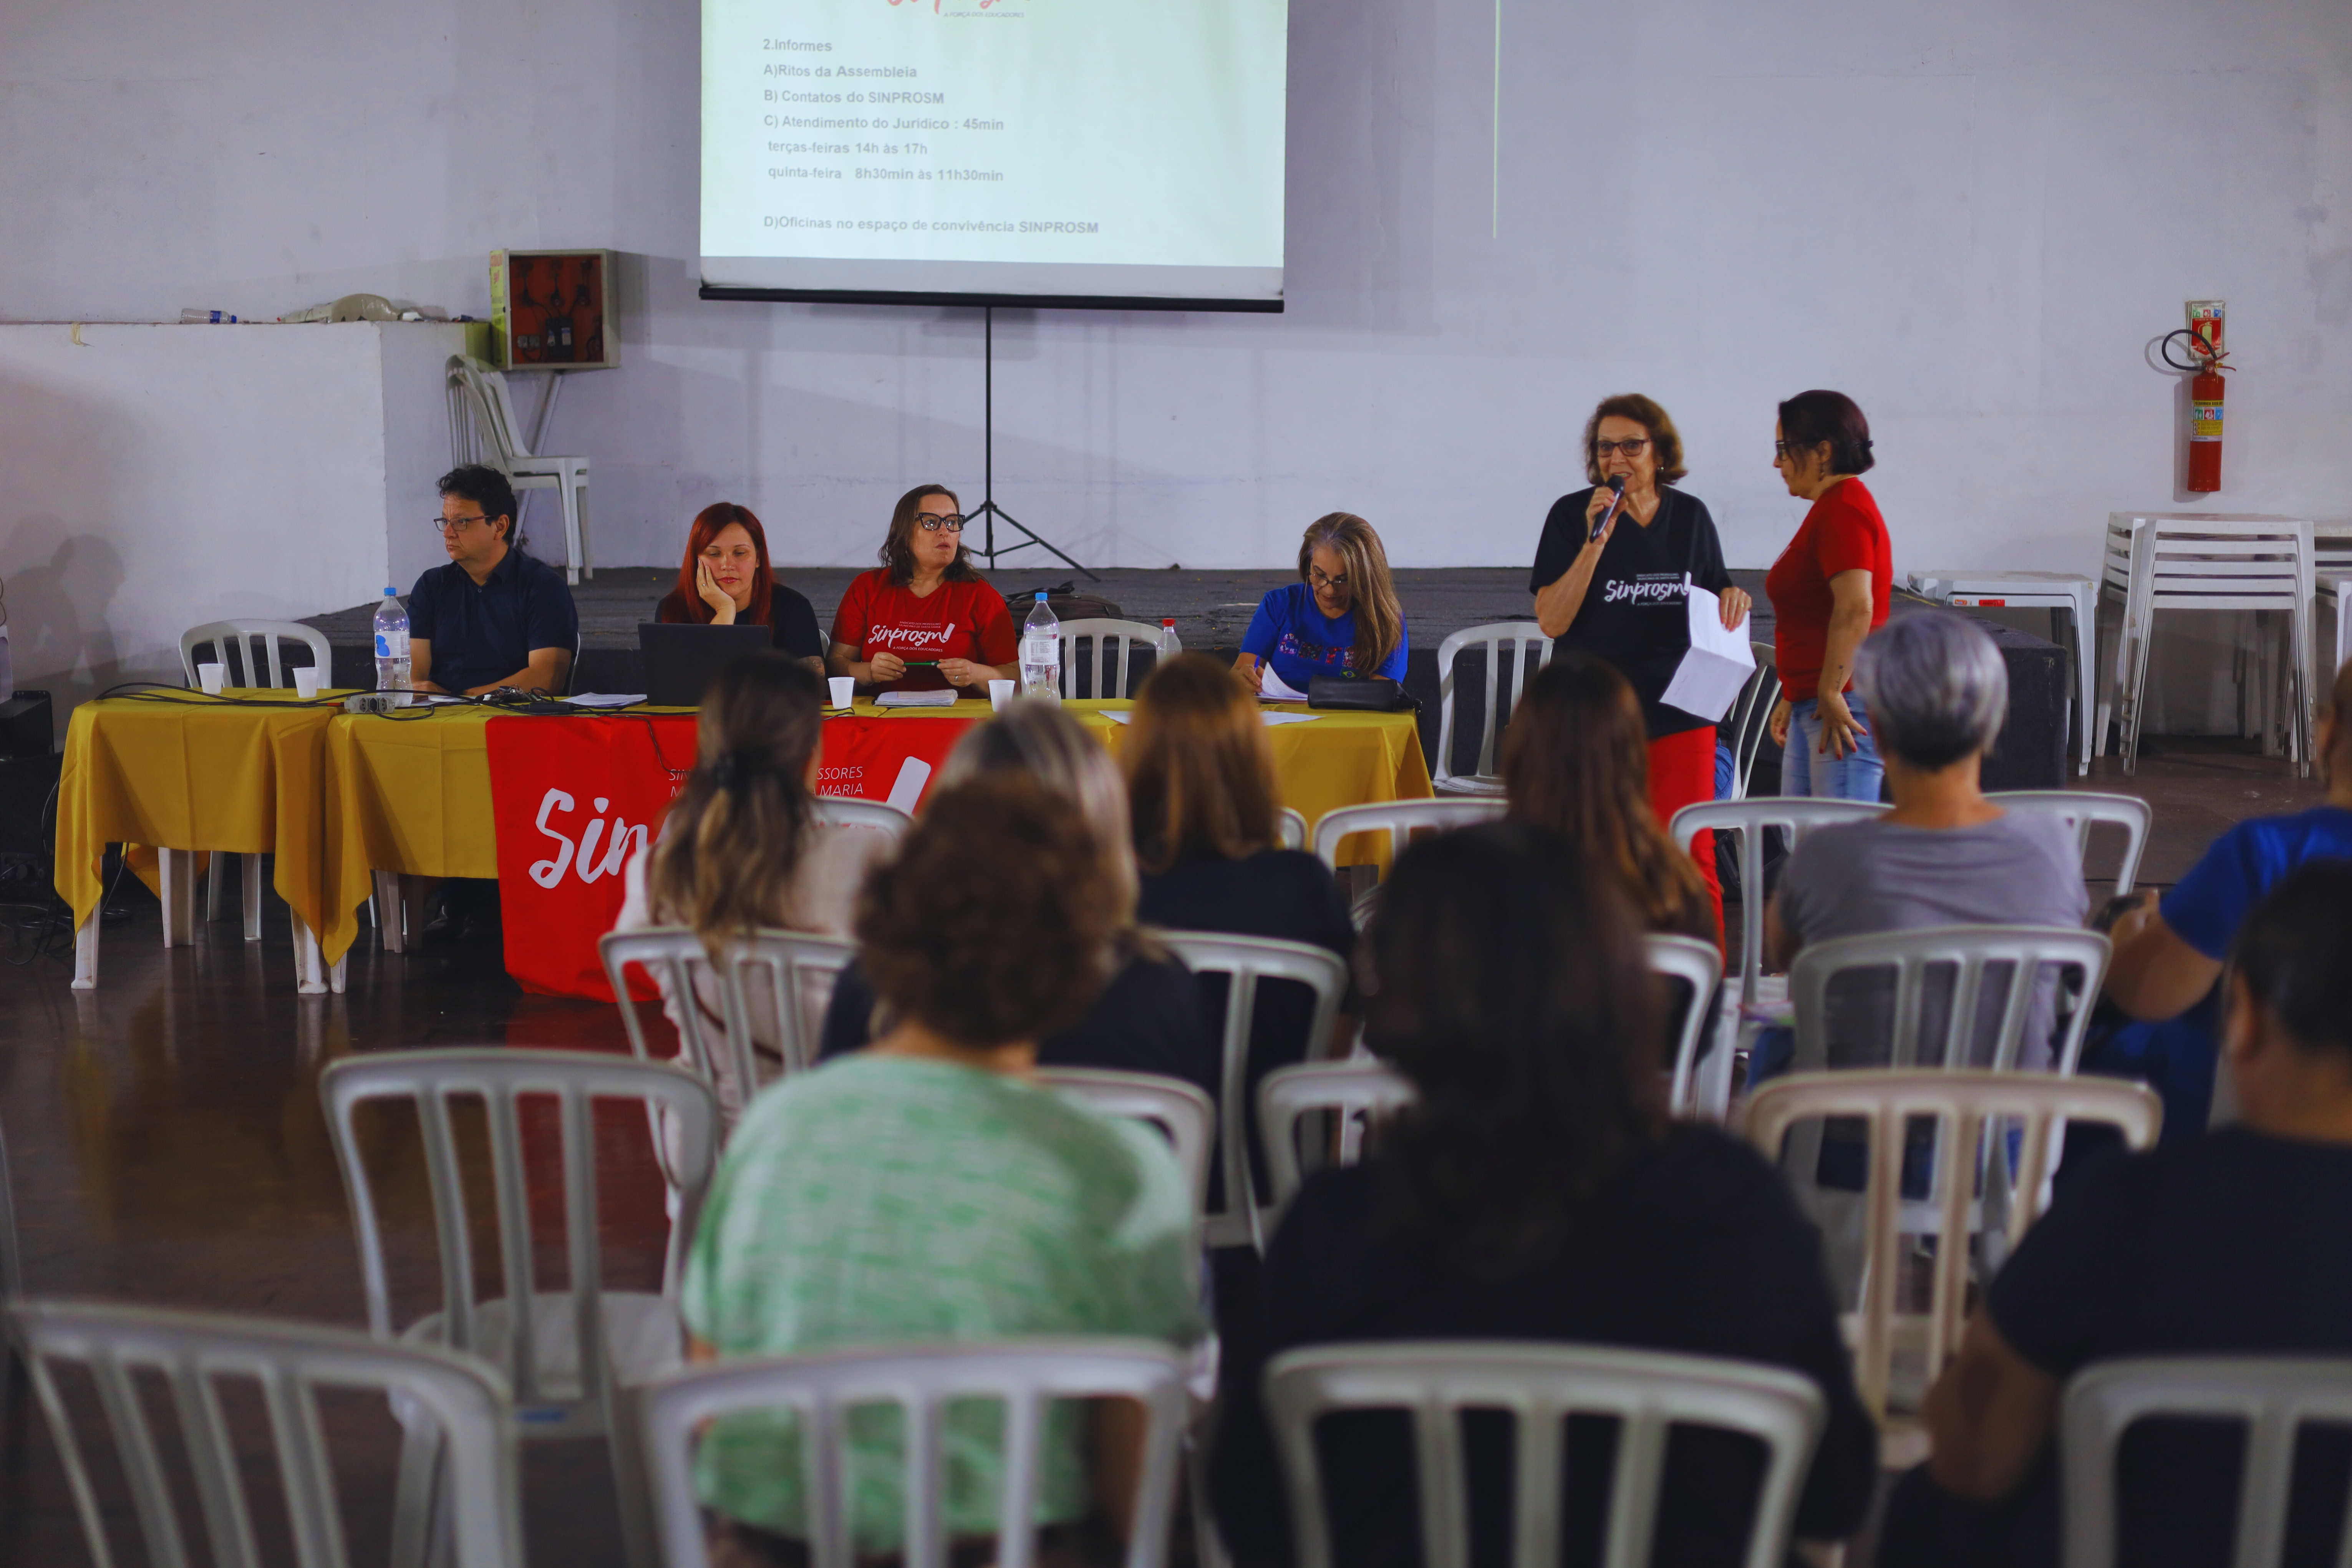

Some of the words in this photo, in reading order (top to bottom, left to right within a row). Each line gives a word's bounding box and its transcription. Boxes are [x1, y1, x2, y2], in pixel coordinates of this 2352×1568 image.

[763, 38, 832, 51] 2.Informes
[764, 64, 810, 78] A)Ritos
[815, 66, 832, 77] da
[836, 66, 917, 78] Assembleia
[764, 90, 777, 103] B)
[782, 90, 841, 103] Contatos
[847, 91, 864, 103] do
[869, 92, 944, 104] SINPROSM
[764, 115, 778, 129] C)
[782, 116, 868, 128] Atendimento
[872, 118, 888, 128] do
[893, 118, 950, 129] Jurídico
[963, 118, 1004, 130] 45min
[768, 141, 850, 154] terças-feiras
[855, 142, 879, 153] 14h
[883, 143, 898, 154] às
[904, 143, 928, 154] 17h
[768, 166, 842, 179] quinta-feira
[855, 168, 913, 179] 8h30min
[918, 169, 932, 180] às
[938, 169, 1003, 181] 11h30min
[764, 216, 832, 230] D)Oficinas
[837, 219, 854, 229] no
[858, 220, 907, 232] espaço
[912, 219, 927, 230] de
[932, 220, 1014, 231] convivência
[1019, 221, 1098, 233] SINPROSM
[817, 766, 863, 780] SSORES
[820, 782, 863, 796] MARIA
